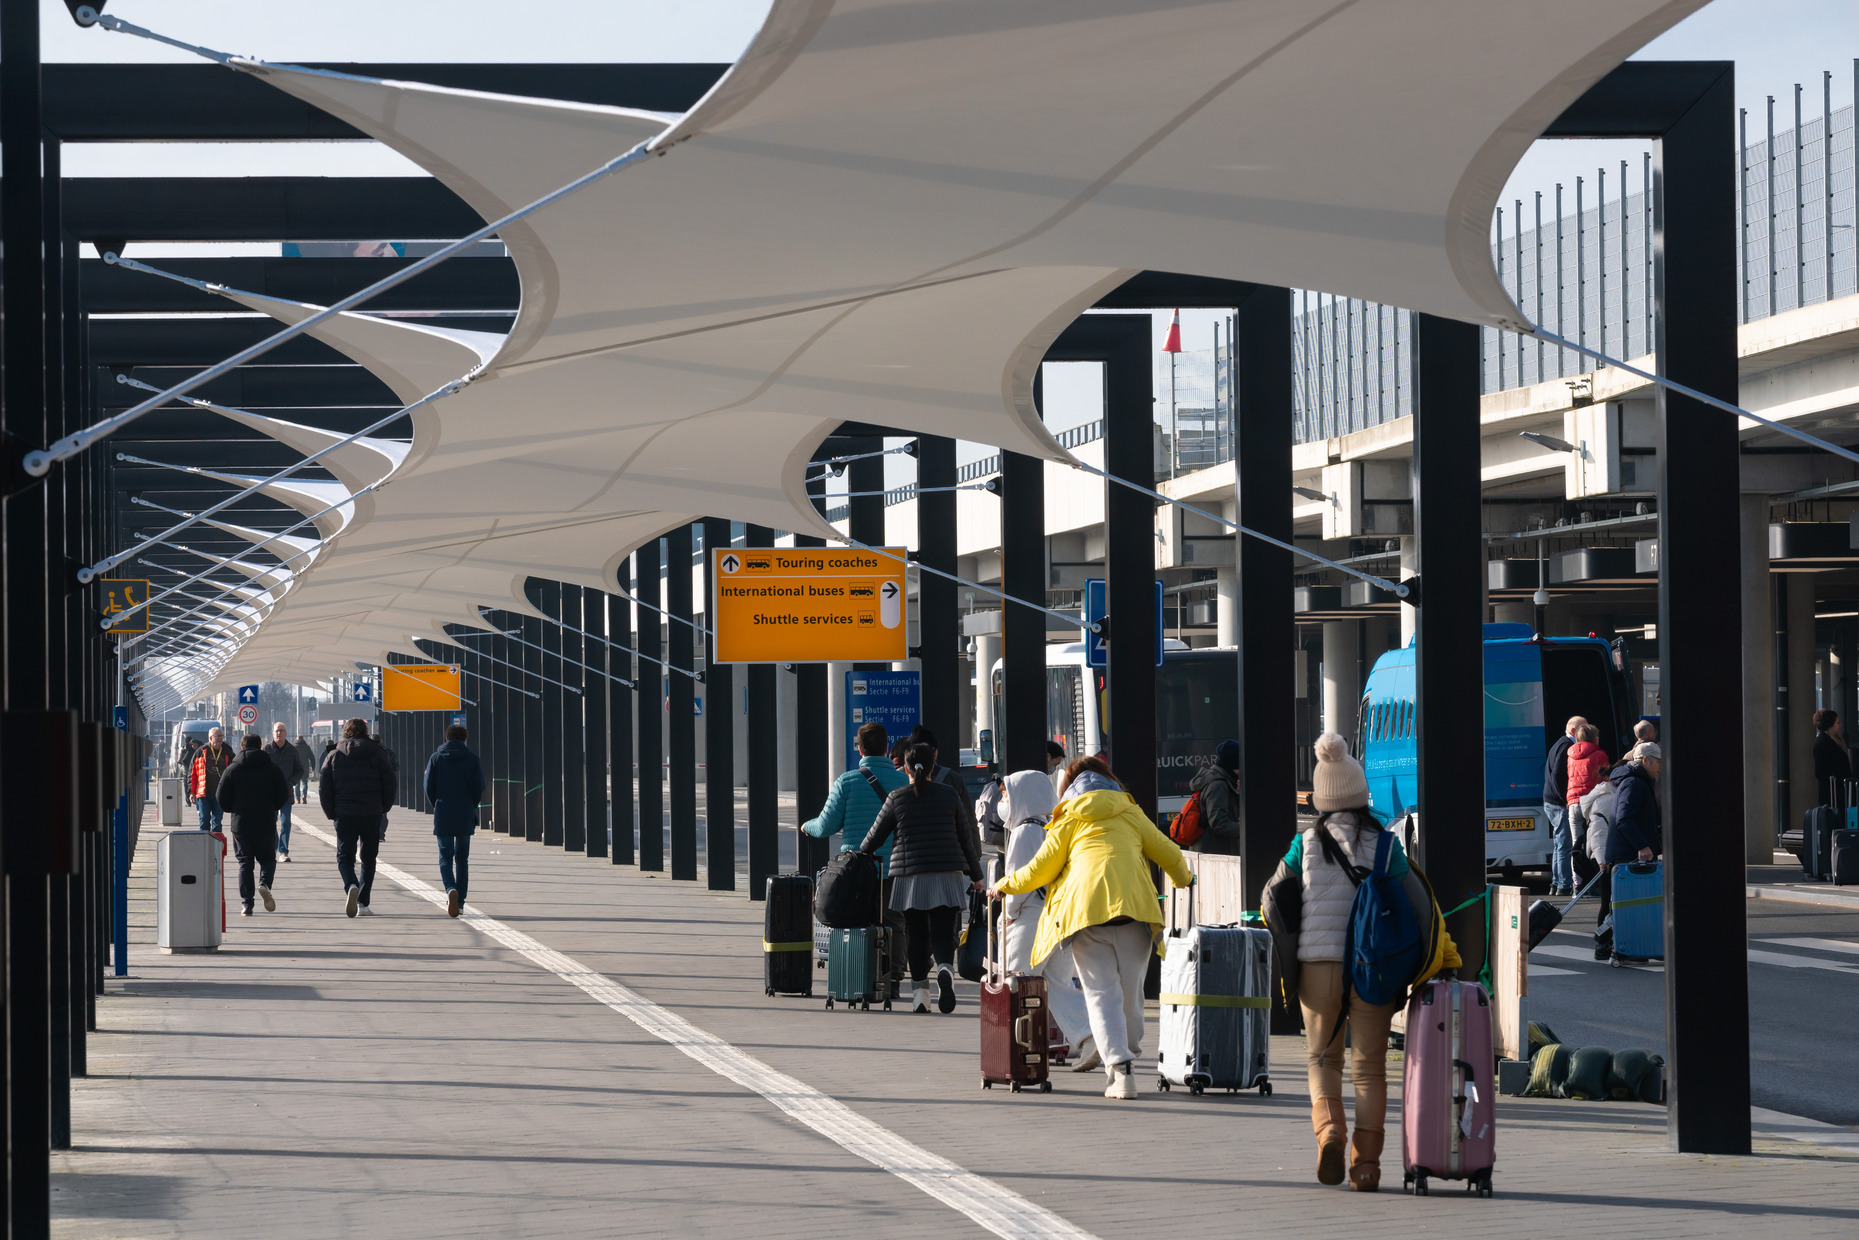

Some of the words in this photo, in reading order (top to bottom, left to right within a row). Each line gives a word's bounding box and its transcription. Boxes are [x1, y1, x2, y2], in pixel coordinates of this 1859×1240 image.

[776, 557, 824, 571] Touring
[828, 556, 878, 568] coaches
[721, 585, 804, 597] International
[809, 585, 845, 596] buses
[753, 614, 799, 625] Shuttle
[803, 613, 853, 624] services
[869, 678, 912, 686] International
[869, 687, 888, 695] Sectie
[892, 687, 909, 695] F6-F9
[242, 710, 255, 719] 30
[865, 706, 888, 714] Shuttle
[865, 715, 884, 723] Sectie
[1490, 820, 1531, 829] 72-BXH-2
